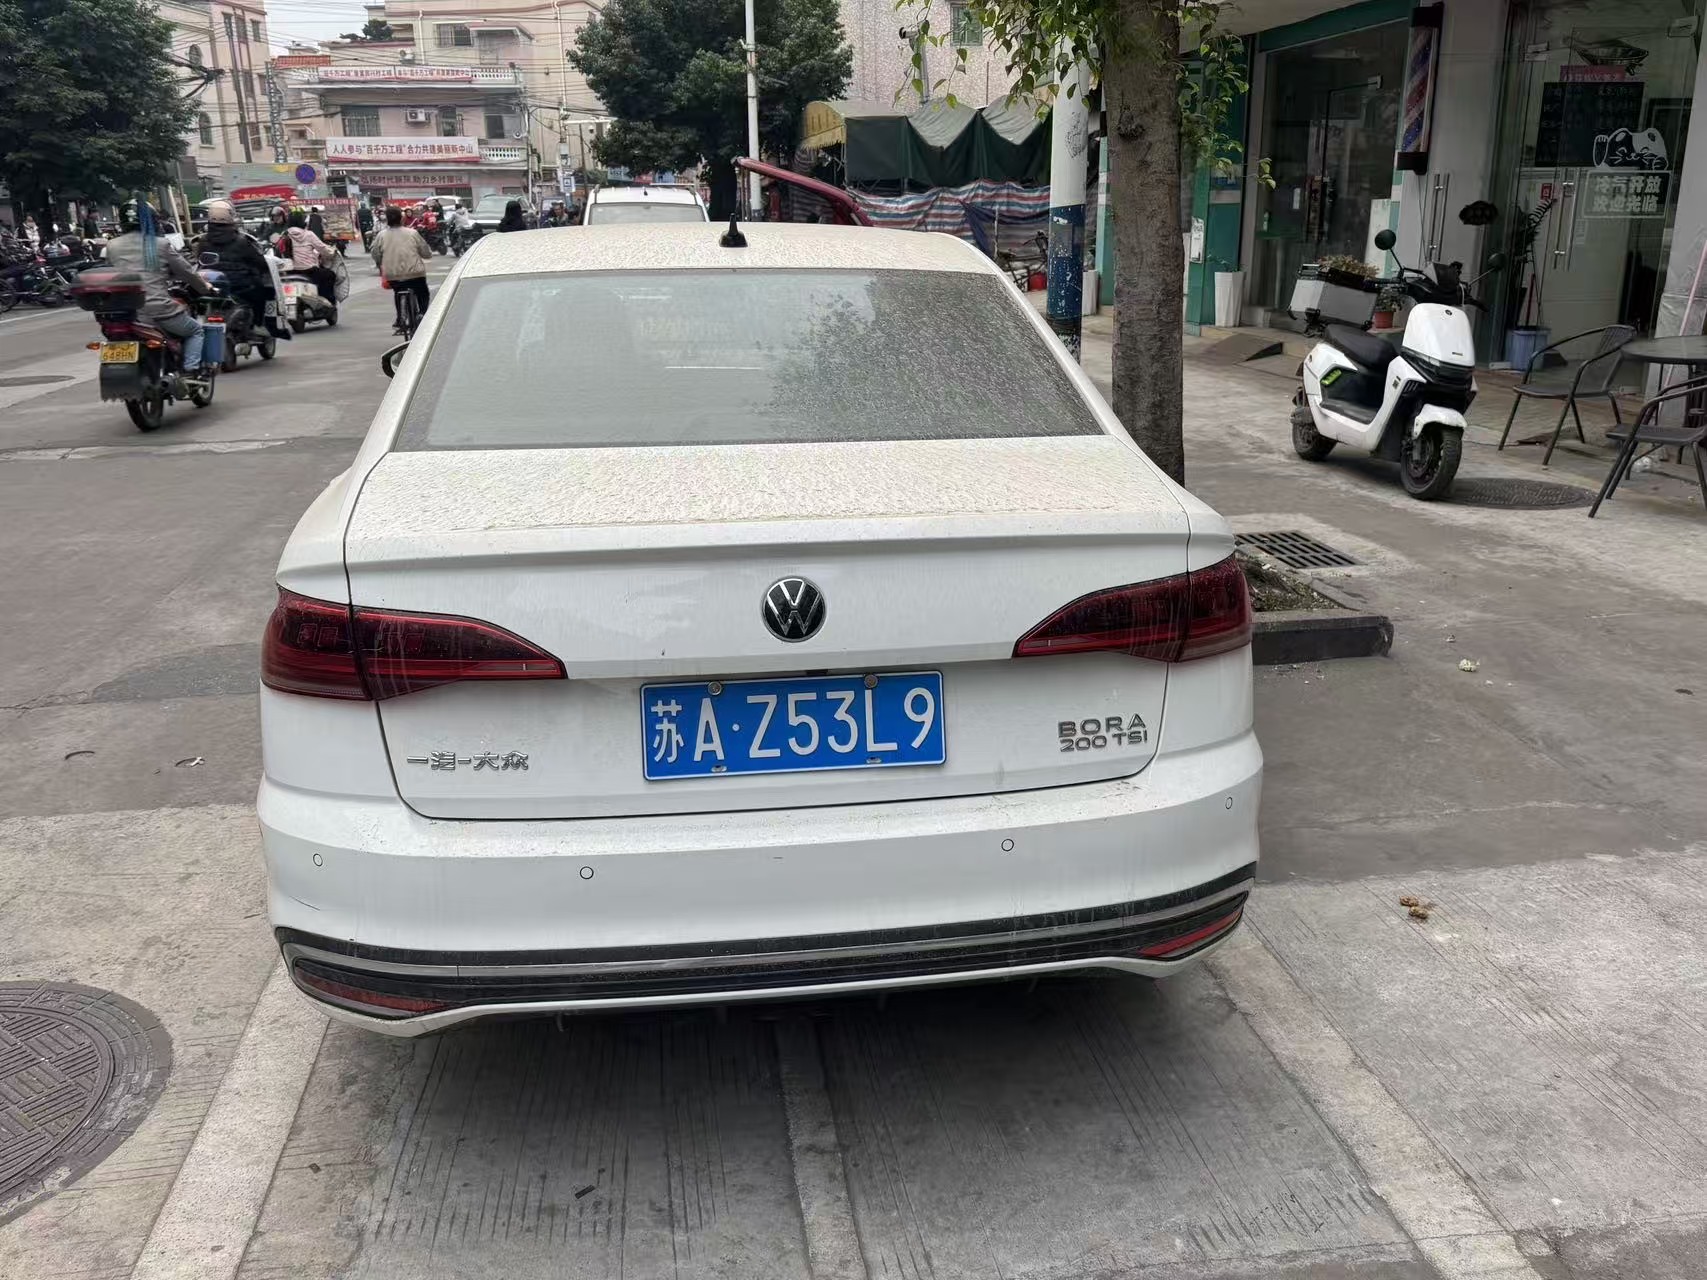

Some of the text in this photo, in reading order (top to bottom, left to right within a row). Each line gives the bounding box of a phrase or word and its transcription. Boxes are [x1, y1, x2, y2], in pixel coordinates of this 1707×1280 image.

[1058, 713, 1146, 738] BORA
[1060, 730, 1148, 752] 200 TSI
[407, 750, 529, 771] 一汽-大众
